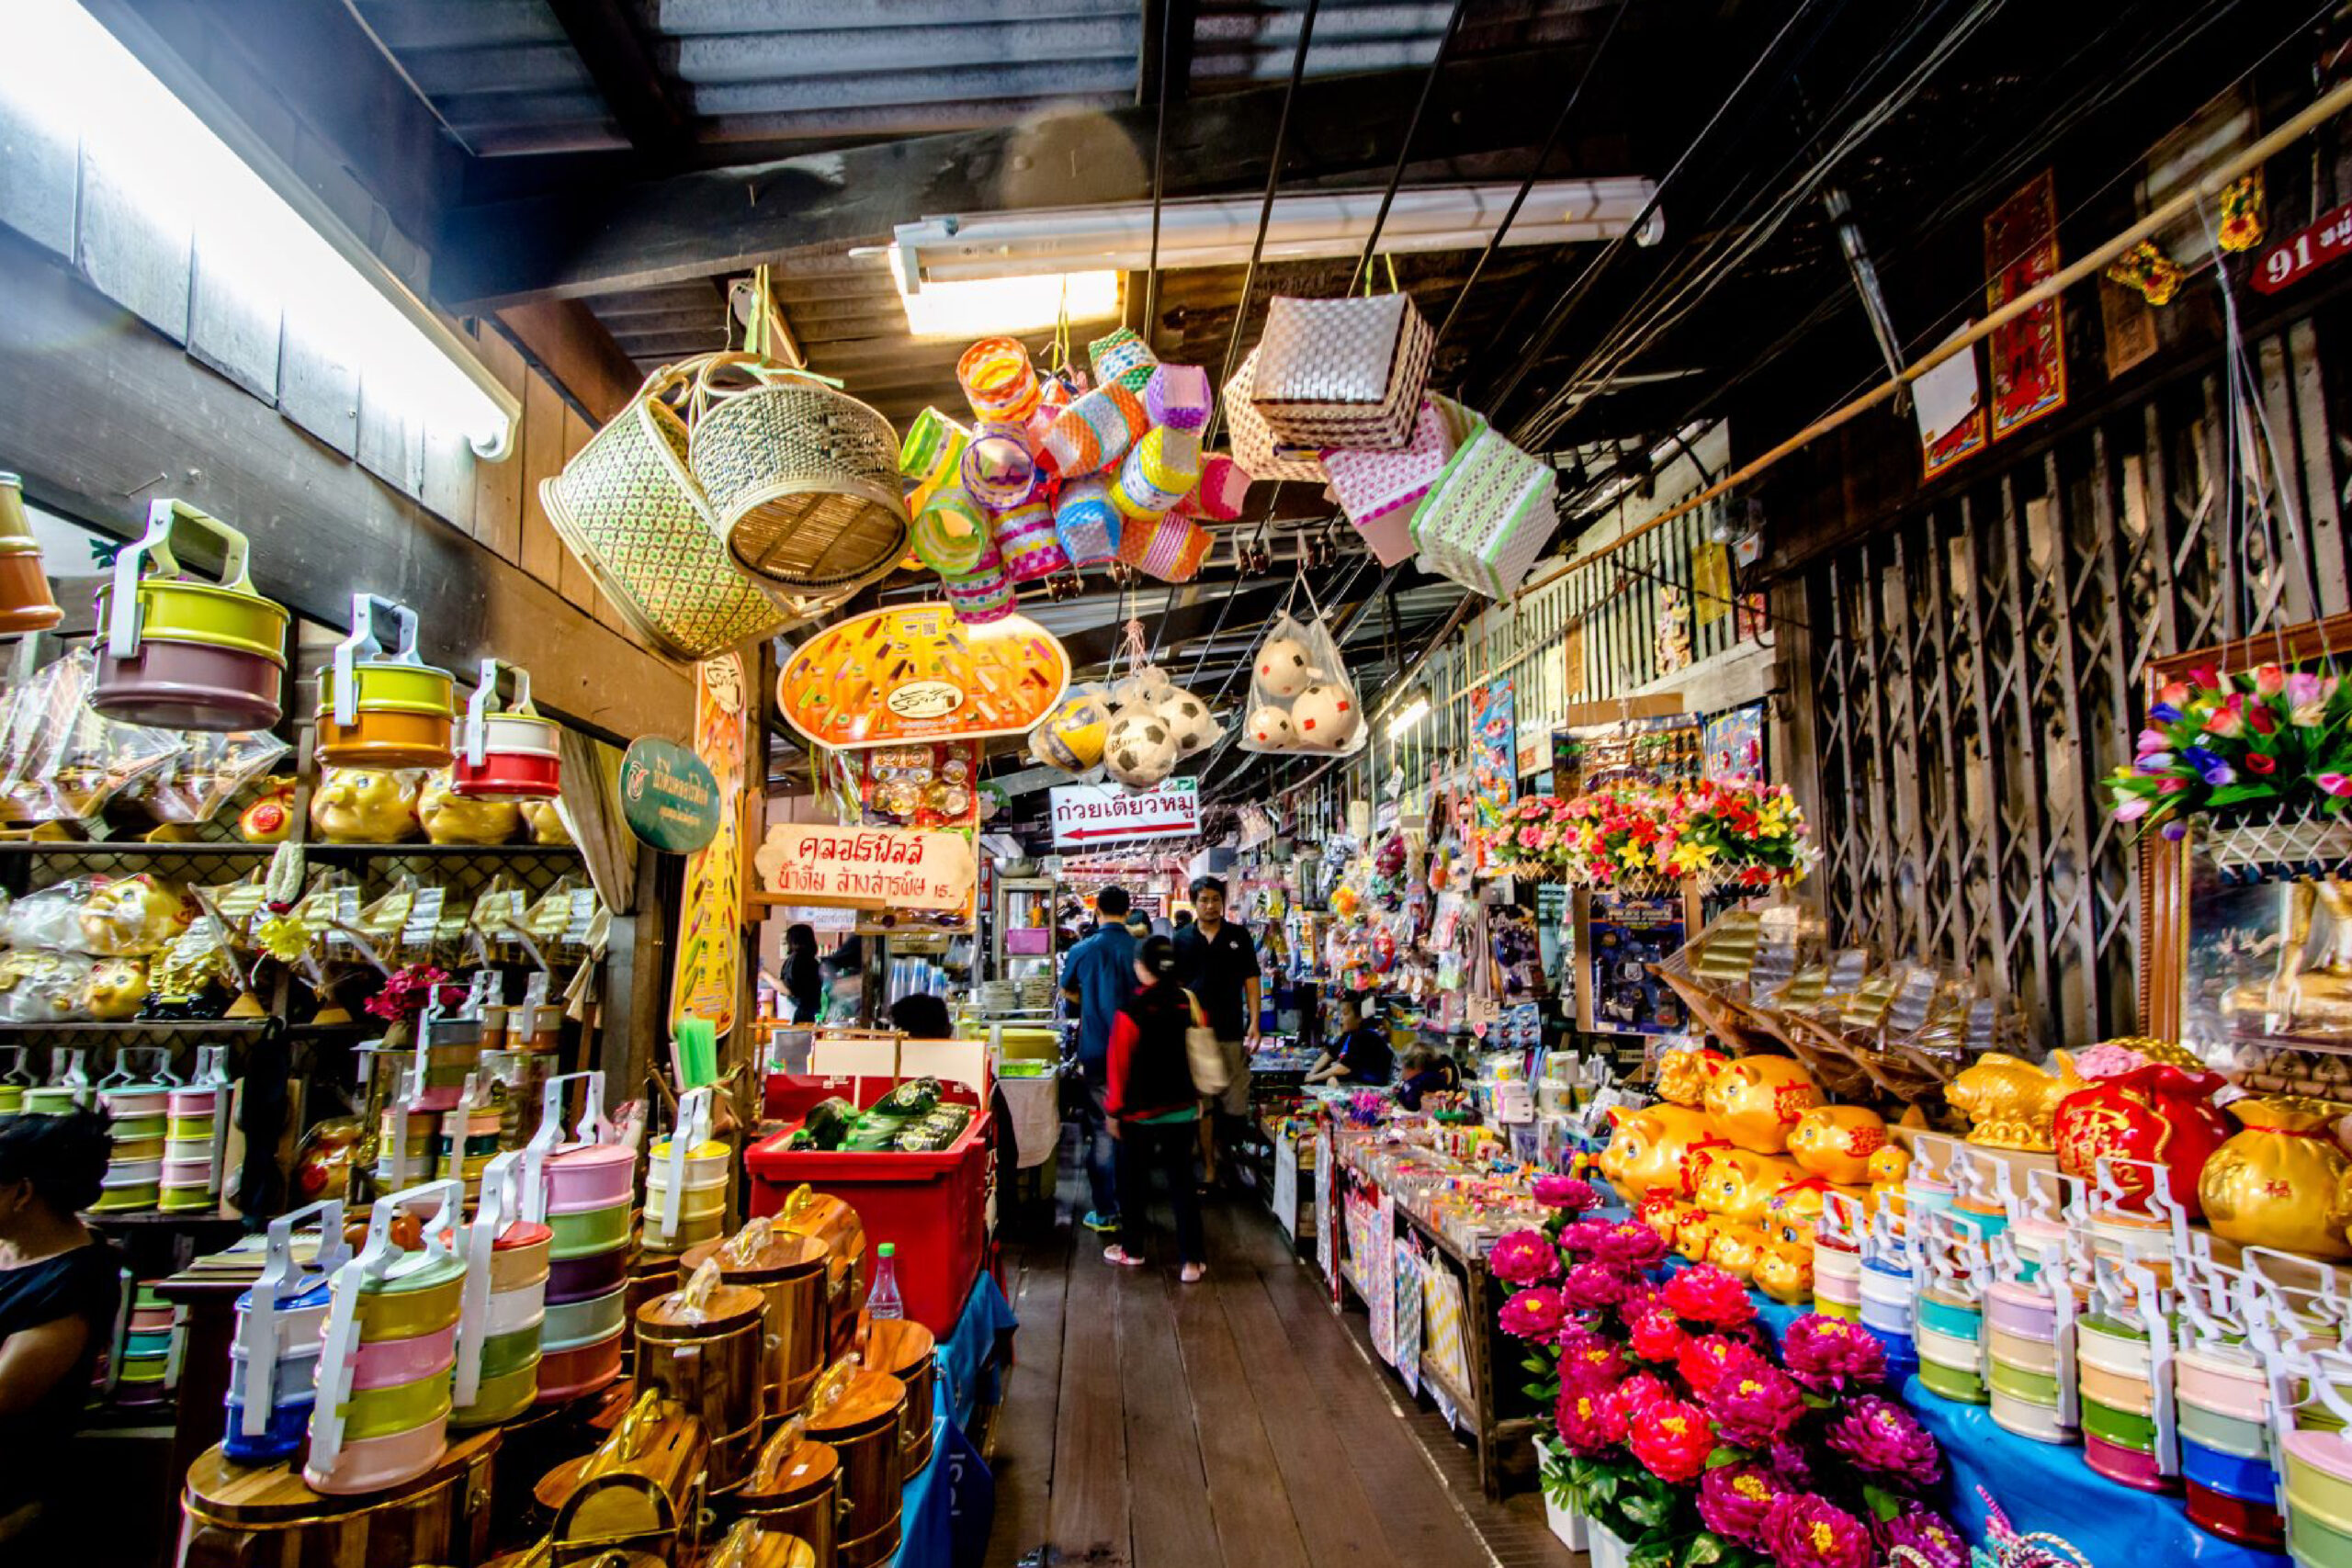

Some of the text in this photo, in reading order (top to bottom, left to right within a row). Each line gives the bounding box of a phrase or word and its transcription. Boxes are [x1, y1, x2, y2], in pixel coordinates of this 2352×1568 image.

[2267, 233, 2313, 284] 91
[1057, 794, 1195, 819] ก๋วยเตียวหมู
